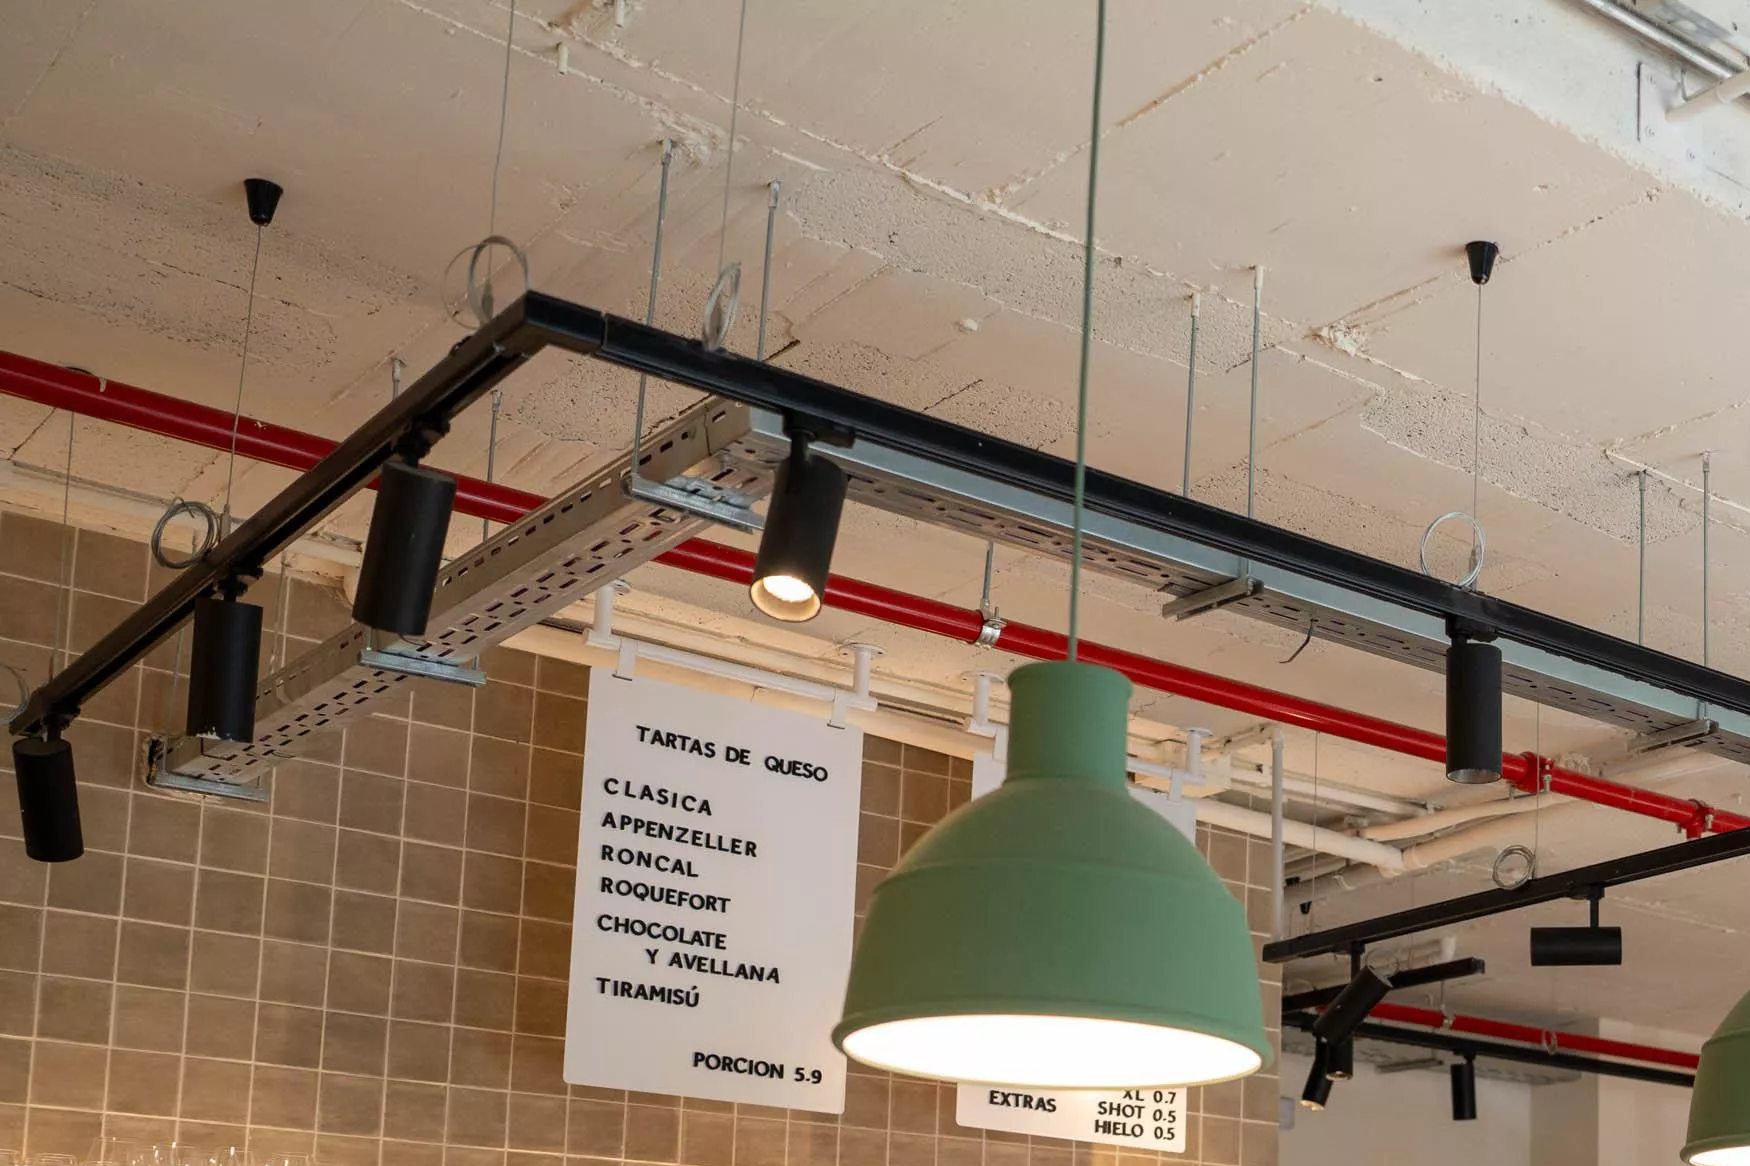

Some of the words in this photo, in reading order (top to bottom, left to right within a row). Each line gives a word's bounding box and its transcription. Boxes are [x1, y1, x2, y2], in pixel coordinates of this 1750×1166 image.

[636, 725, 716, 758] TARTAS
[725, 746, 751, 765] DE
[764, 756, 828, 782] QUESO
[603, 778, 712, 816] CLASICA
[601, 812, 758, 858] APPENZELLER
[601, 845, 699, 878] RONCAL
[600, 877, 731, 914] ROQUEFORT
[597, 914, 727, 950] CHOCOLATE
[645, 949, 660, 965] Y
[668, 952, 780, 984] AVELLANA
[596, 976, 699, 1008] TIRAMISÚ
[692, 1052, 784, 1080] PORCION
[794, 1067, 822, 1085] 5.9
[989, 1090, 1057, 1113] EXTRAS
[1097, 1101, 1146, 1119] SHOT
[1152, 1108, 1176, 1123] 0.5
[1122, 1089, 1145, 1102] XL
[1153, 1090, 1176, 1105] 0.7
[1094, 1119, 1144, 1138] HIELO
[1153, 1126, 1176, 1141] 0.5
